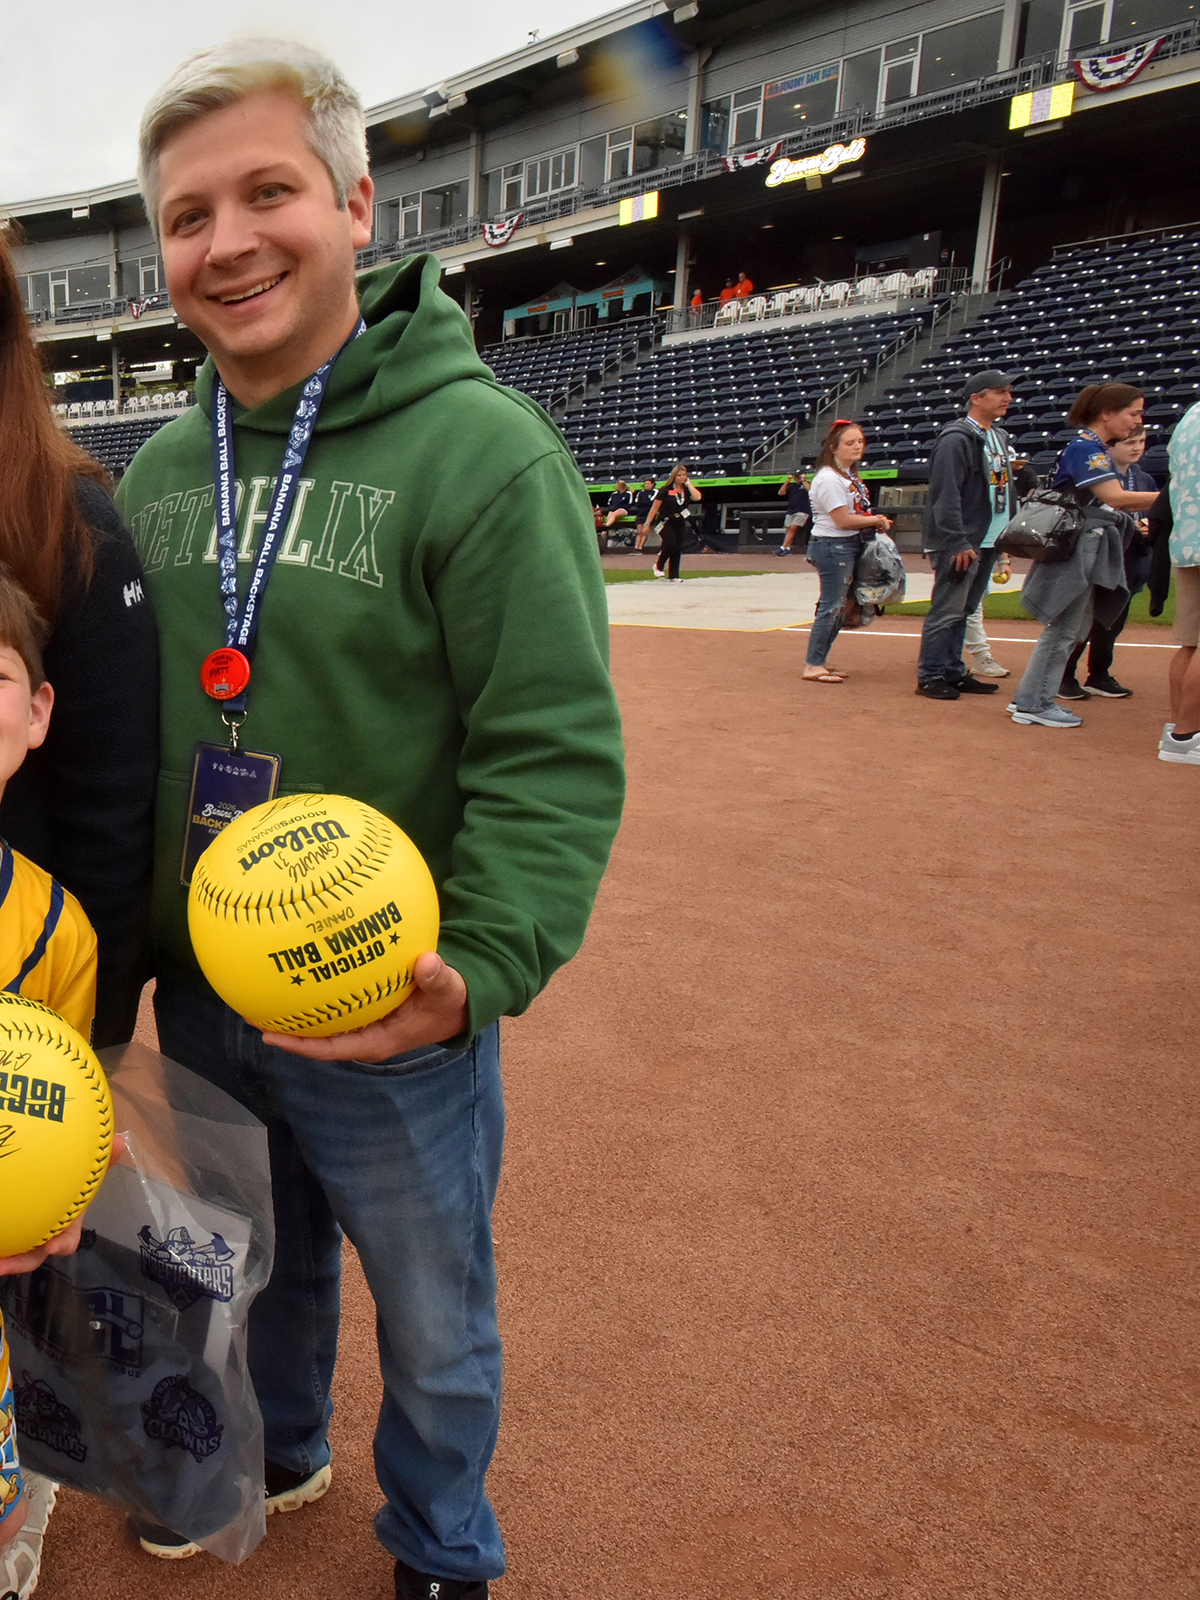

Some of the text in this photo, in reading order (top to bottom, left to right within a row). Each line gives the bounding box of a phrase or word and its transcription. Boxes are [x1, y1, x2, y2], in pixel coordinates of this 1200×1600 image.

[217, 381, 230, 526] BANANA BALL BACKSTA
[238, 474, 292, 645] BANANA BALL BACKSTAGE
[192, 814, 230, 831] BACKS
[202, 803, 233, 818] Banana
[218, 802, 237, 811] 2026
[238, 819, 350, 872] Wilson
[268, 901, 403, 973] BANANA BALL
[306, 906, 355, 934] DANIEL
[308, 940, 386, 983] OFFICIAL
[141, 1248, 234, 1298] FIREFIGHTERS
[147, 1419, 220, 1454] CLOWNS
